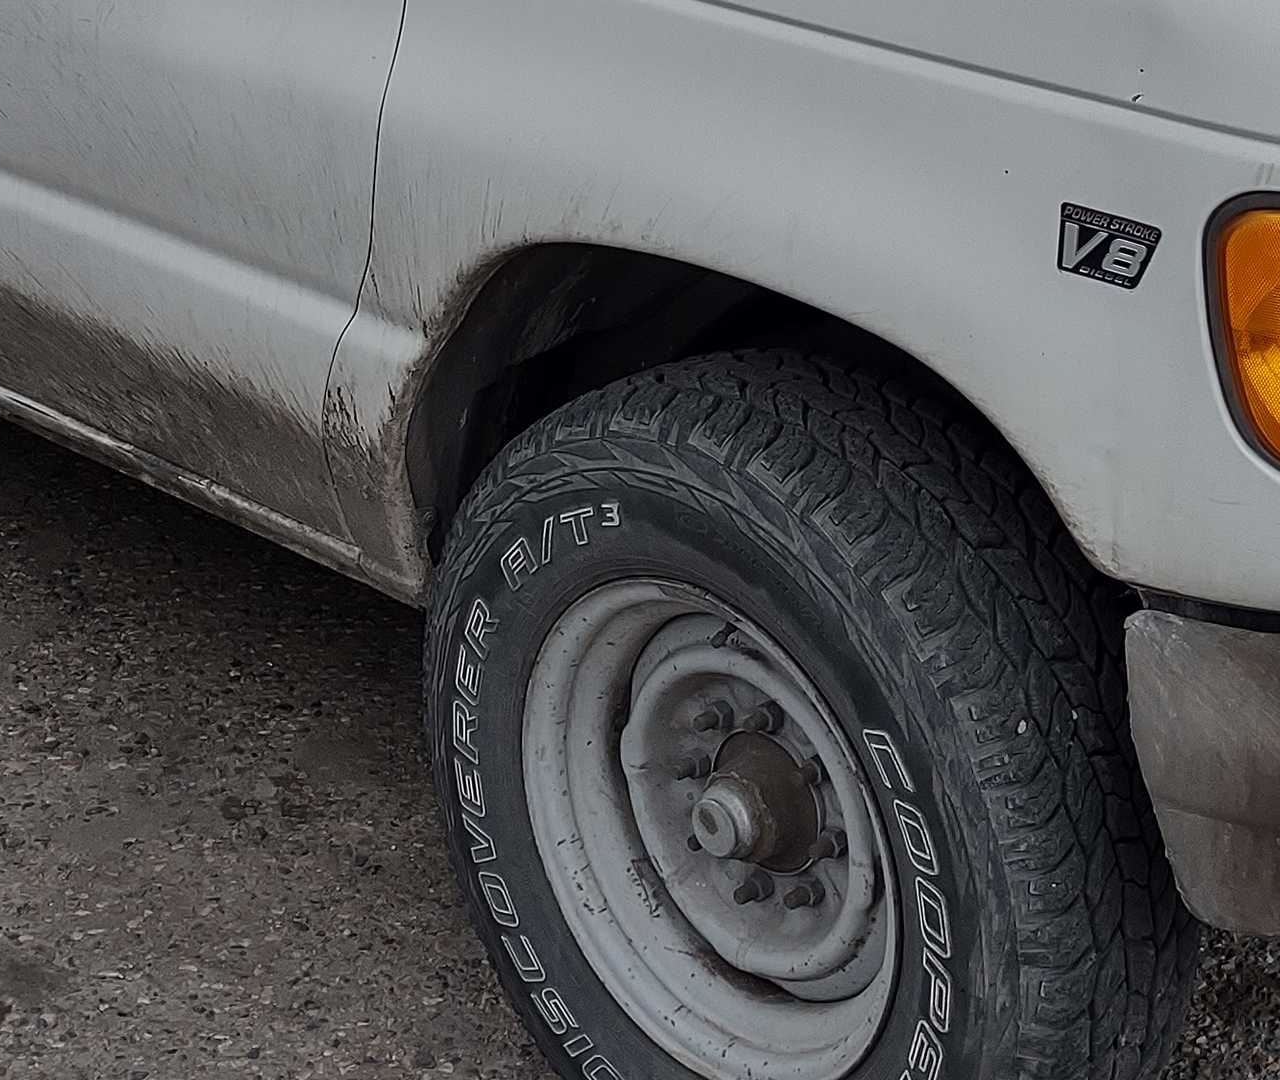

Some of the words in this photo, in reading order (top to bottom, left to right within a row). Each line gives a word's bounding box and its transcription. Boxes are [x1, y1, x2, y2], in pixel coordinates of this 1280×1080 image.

[1064, 206, 1108, 228] POWER
[1110, 219, 1159, 241] STROKE
[1062, 222, 1147, 277] V8
[1079, 266, 1133, 286] DIESEL
[863, 729, 951, 1080] COOPE
